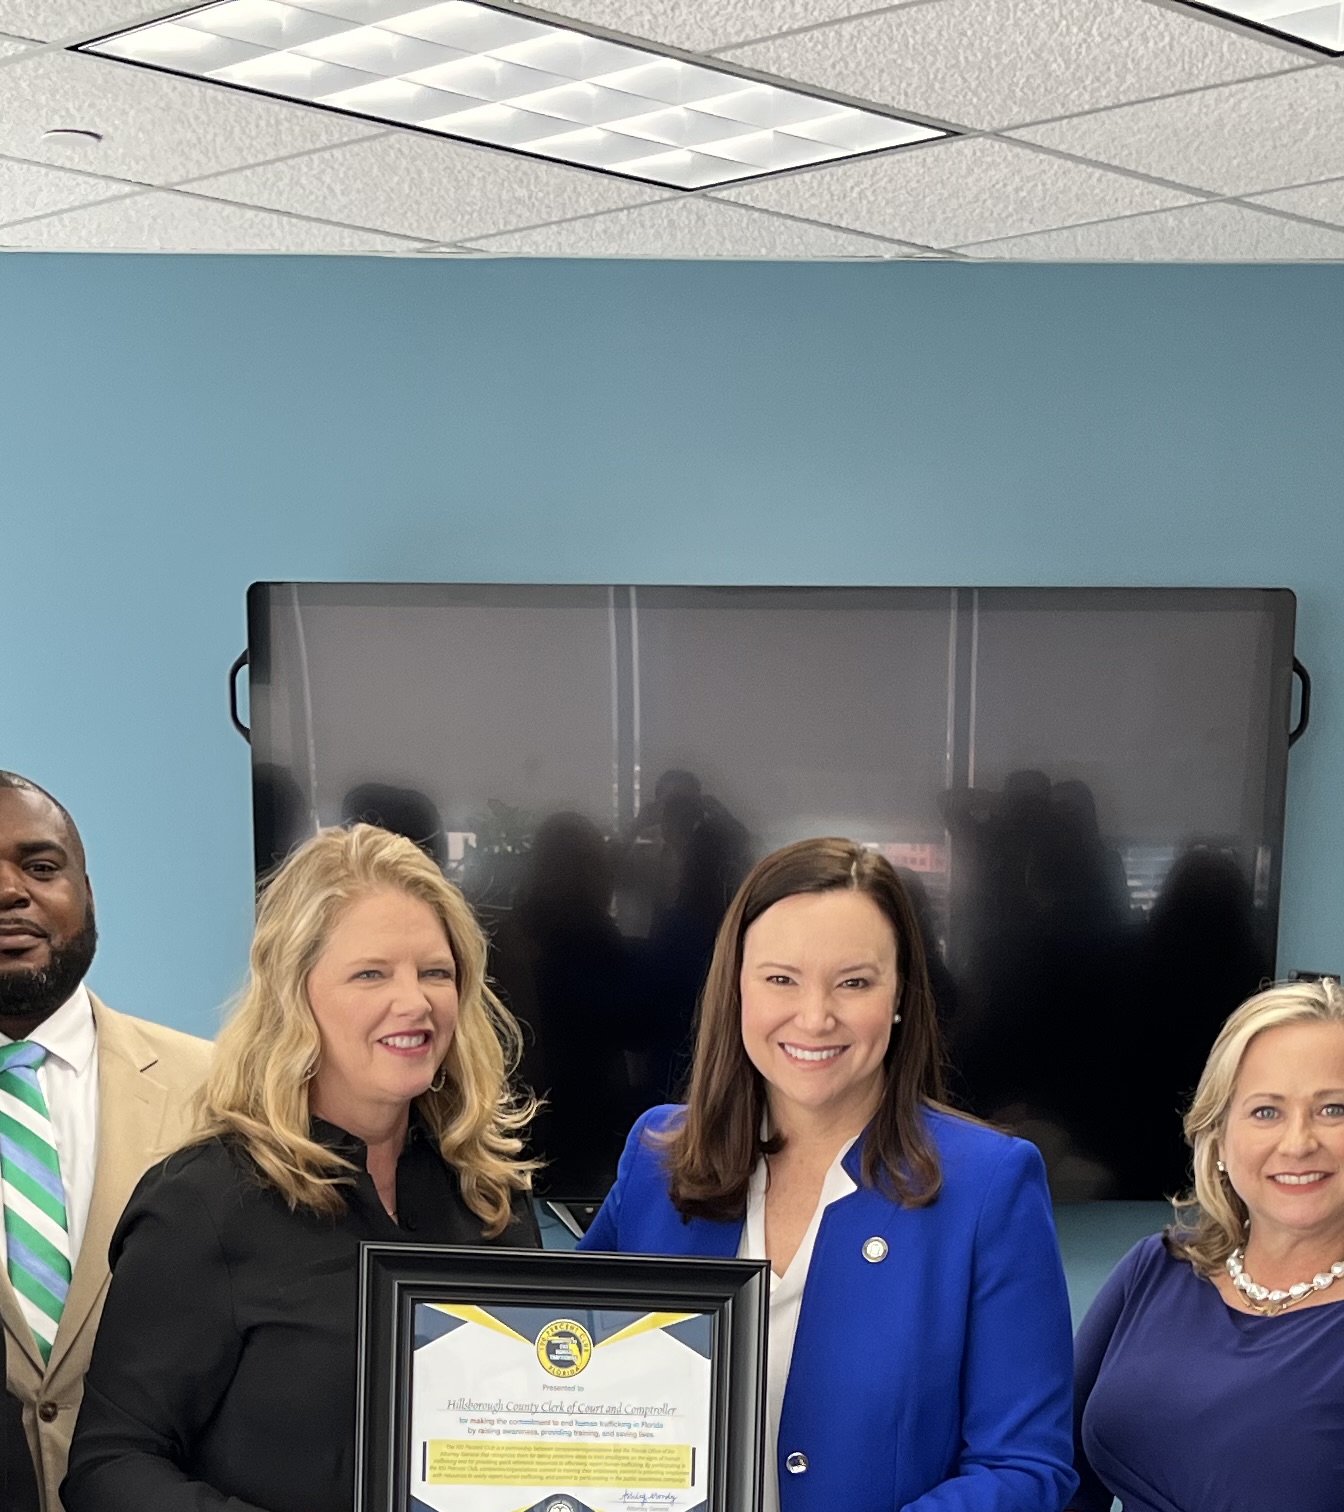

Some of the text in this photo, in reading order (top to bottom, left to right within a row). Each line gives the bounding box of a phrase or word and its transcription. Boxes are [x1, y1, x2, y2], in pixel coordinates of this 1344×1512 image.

[542, 1383, 585, 1392] Presented to
[447, 1398, 678, 1419] Hillsborough County Clerk of Court and Comptroller
[470, 1417, 495, 1426] making
